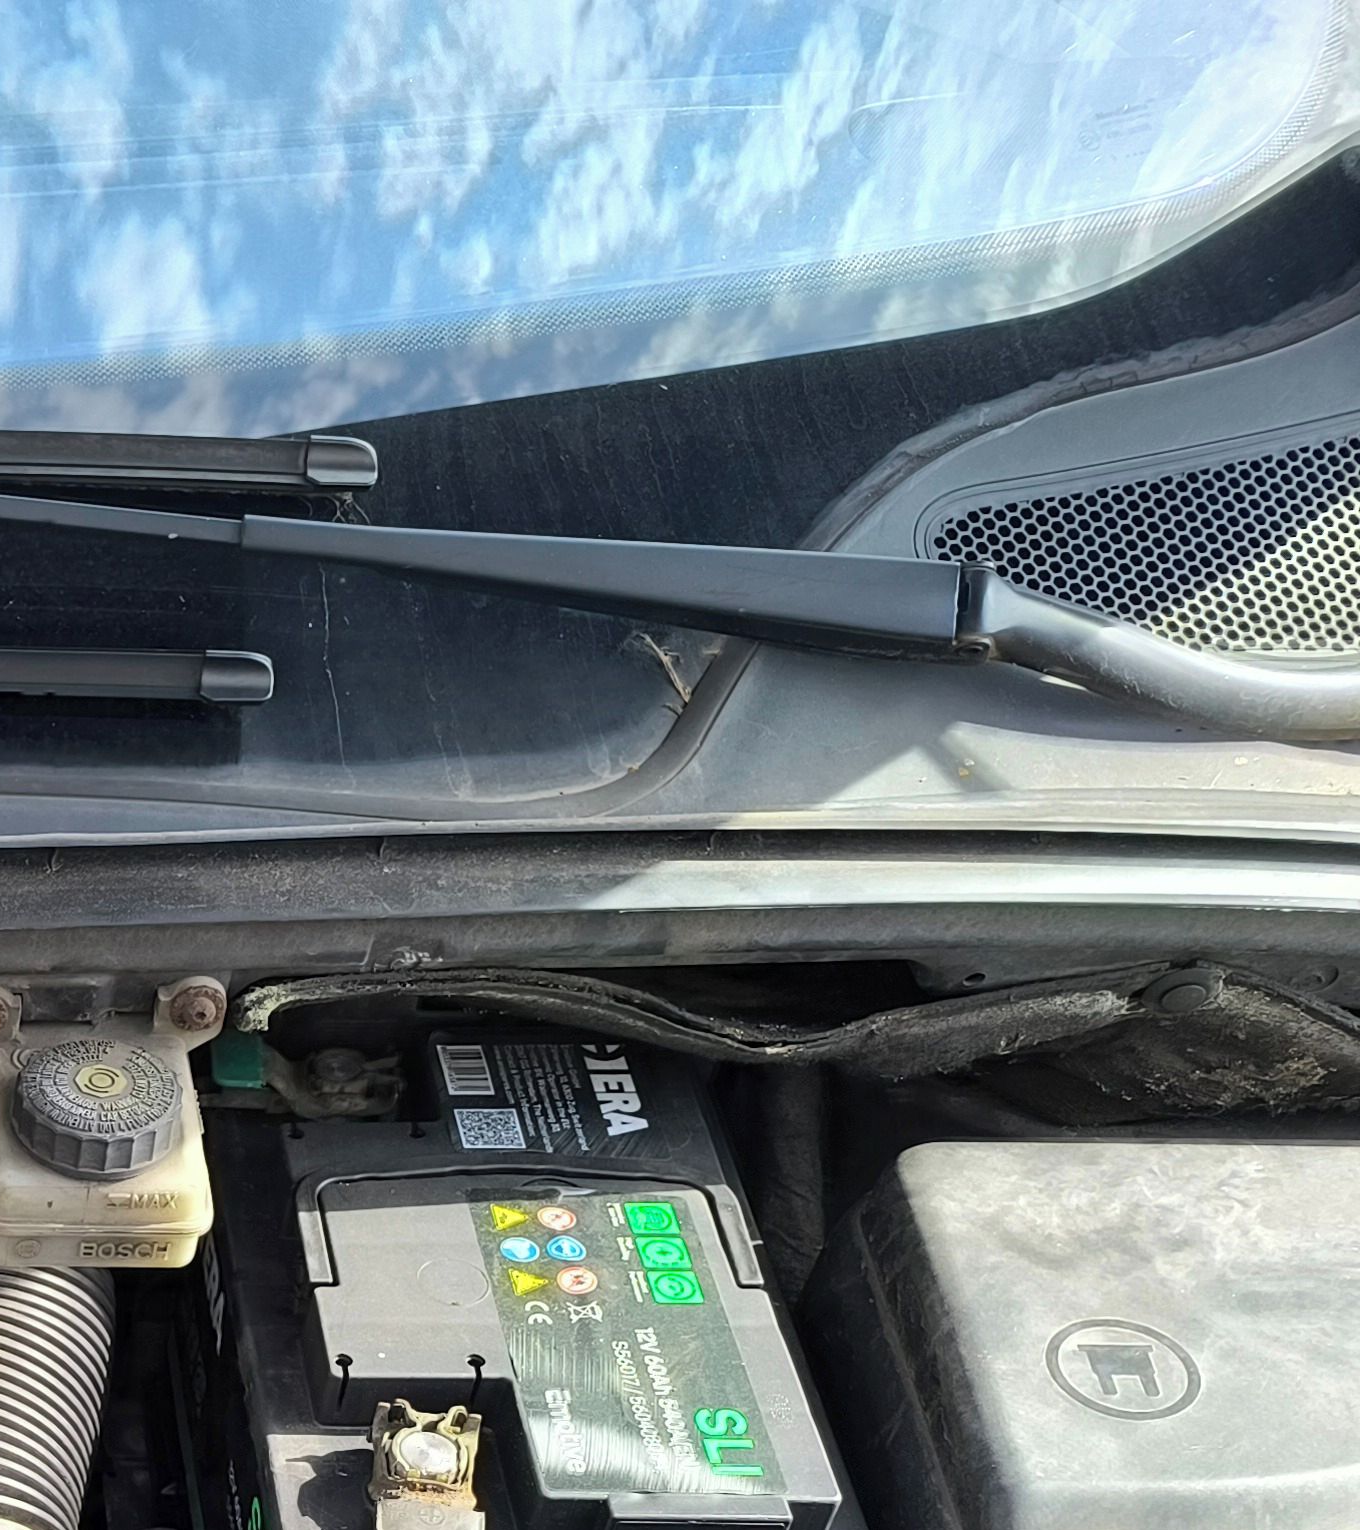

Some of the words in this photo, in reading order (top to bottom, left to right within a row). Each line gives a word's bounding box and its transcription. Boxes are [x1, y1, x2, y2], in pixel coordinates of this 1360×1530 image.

[132, 1192, 180, 1210] MAX
[79, 1241, 172, 1261] BOSCH
[635, 1327, 662, 1354] 12V
[544, 1387, 587, 1476] Emotive
[694, 1407, 764, 1477] SLI
